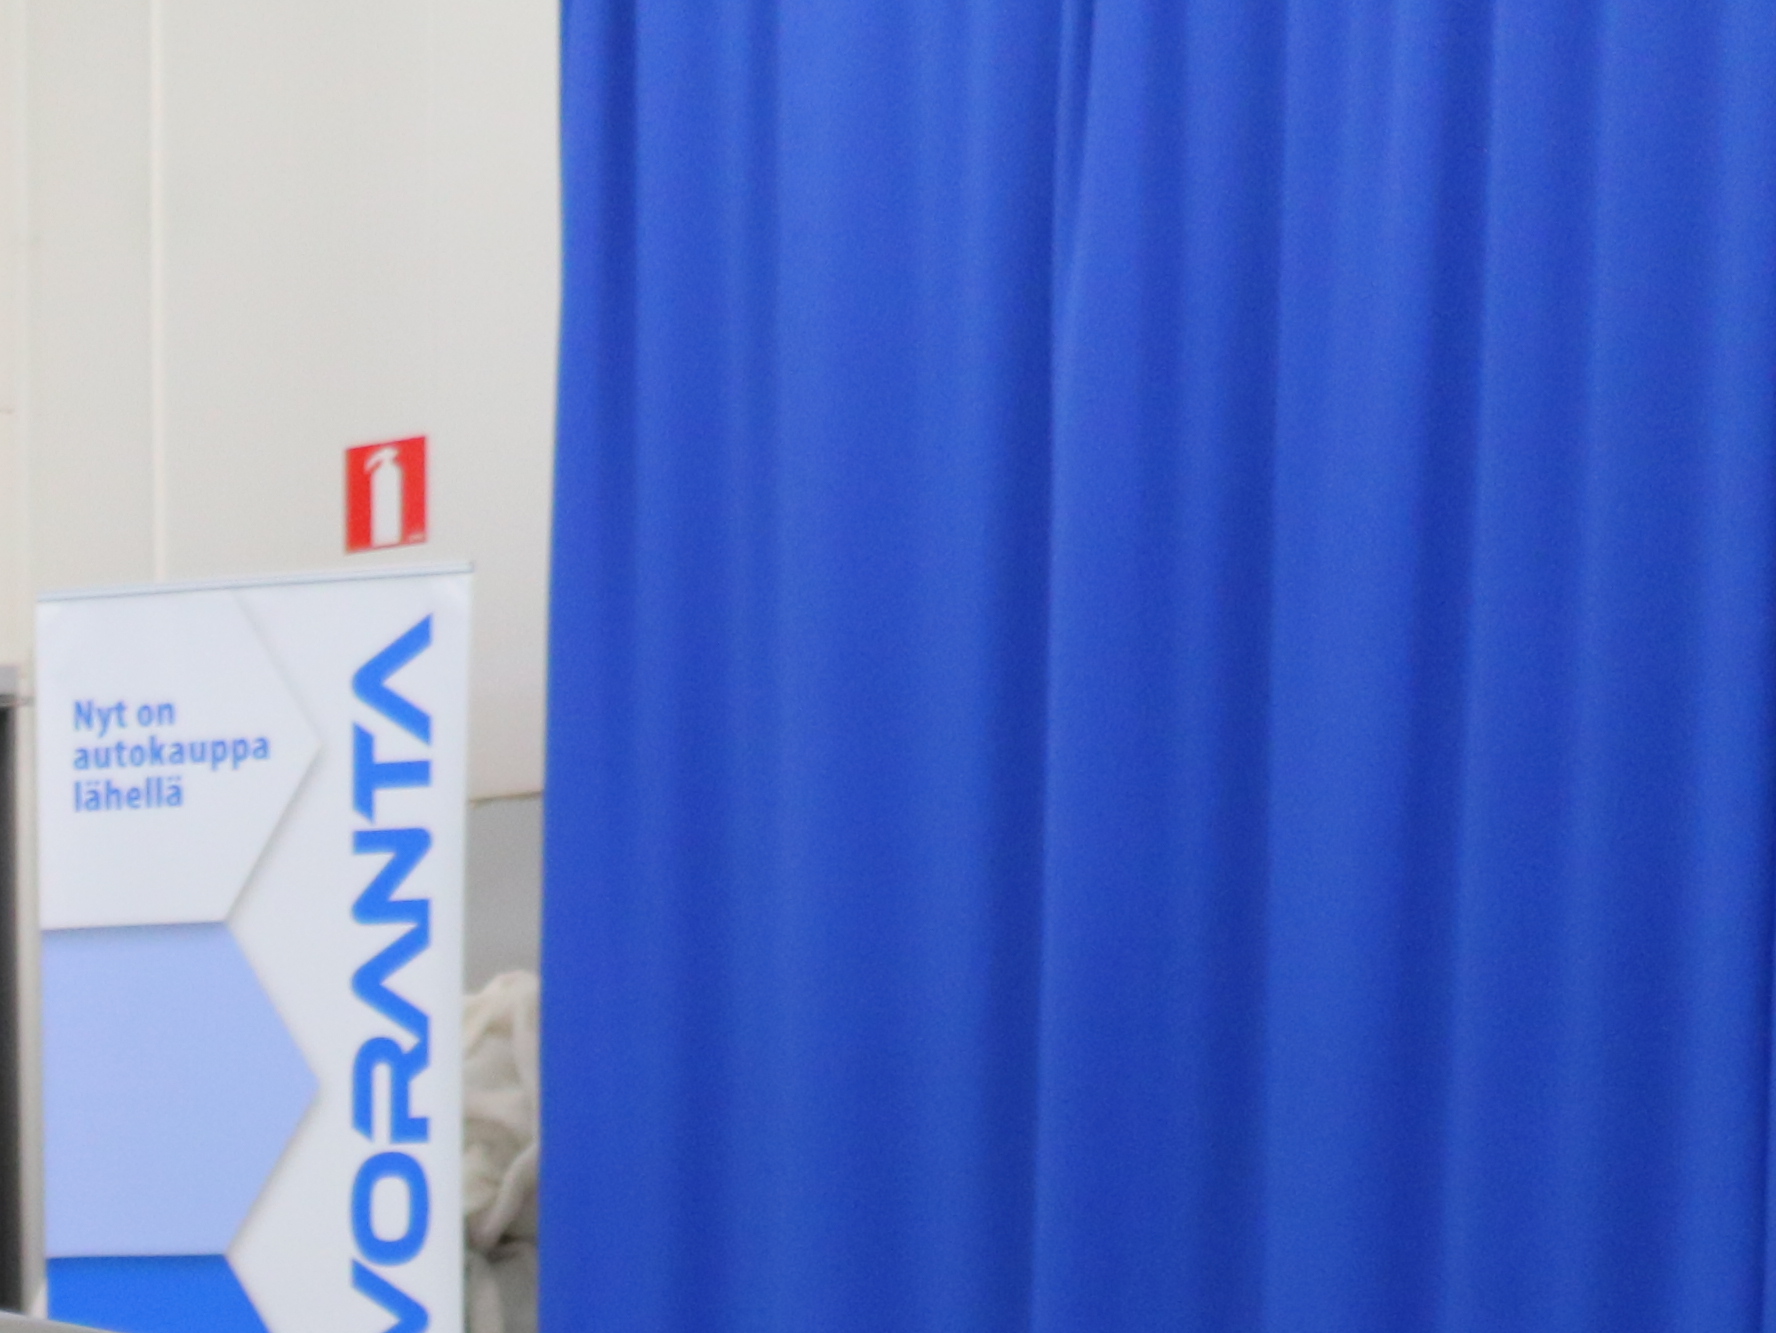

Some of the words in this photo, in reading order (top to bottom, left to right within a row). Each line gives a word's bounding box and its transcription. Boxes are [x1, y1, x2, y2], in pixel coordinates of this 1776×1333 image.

[73, 700, 127, 738] Nyt
[136, 702, 176, 728] on
[73, 736, 271, 771] autokauppa
[73, 775, 184, 812] lähellä
